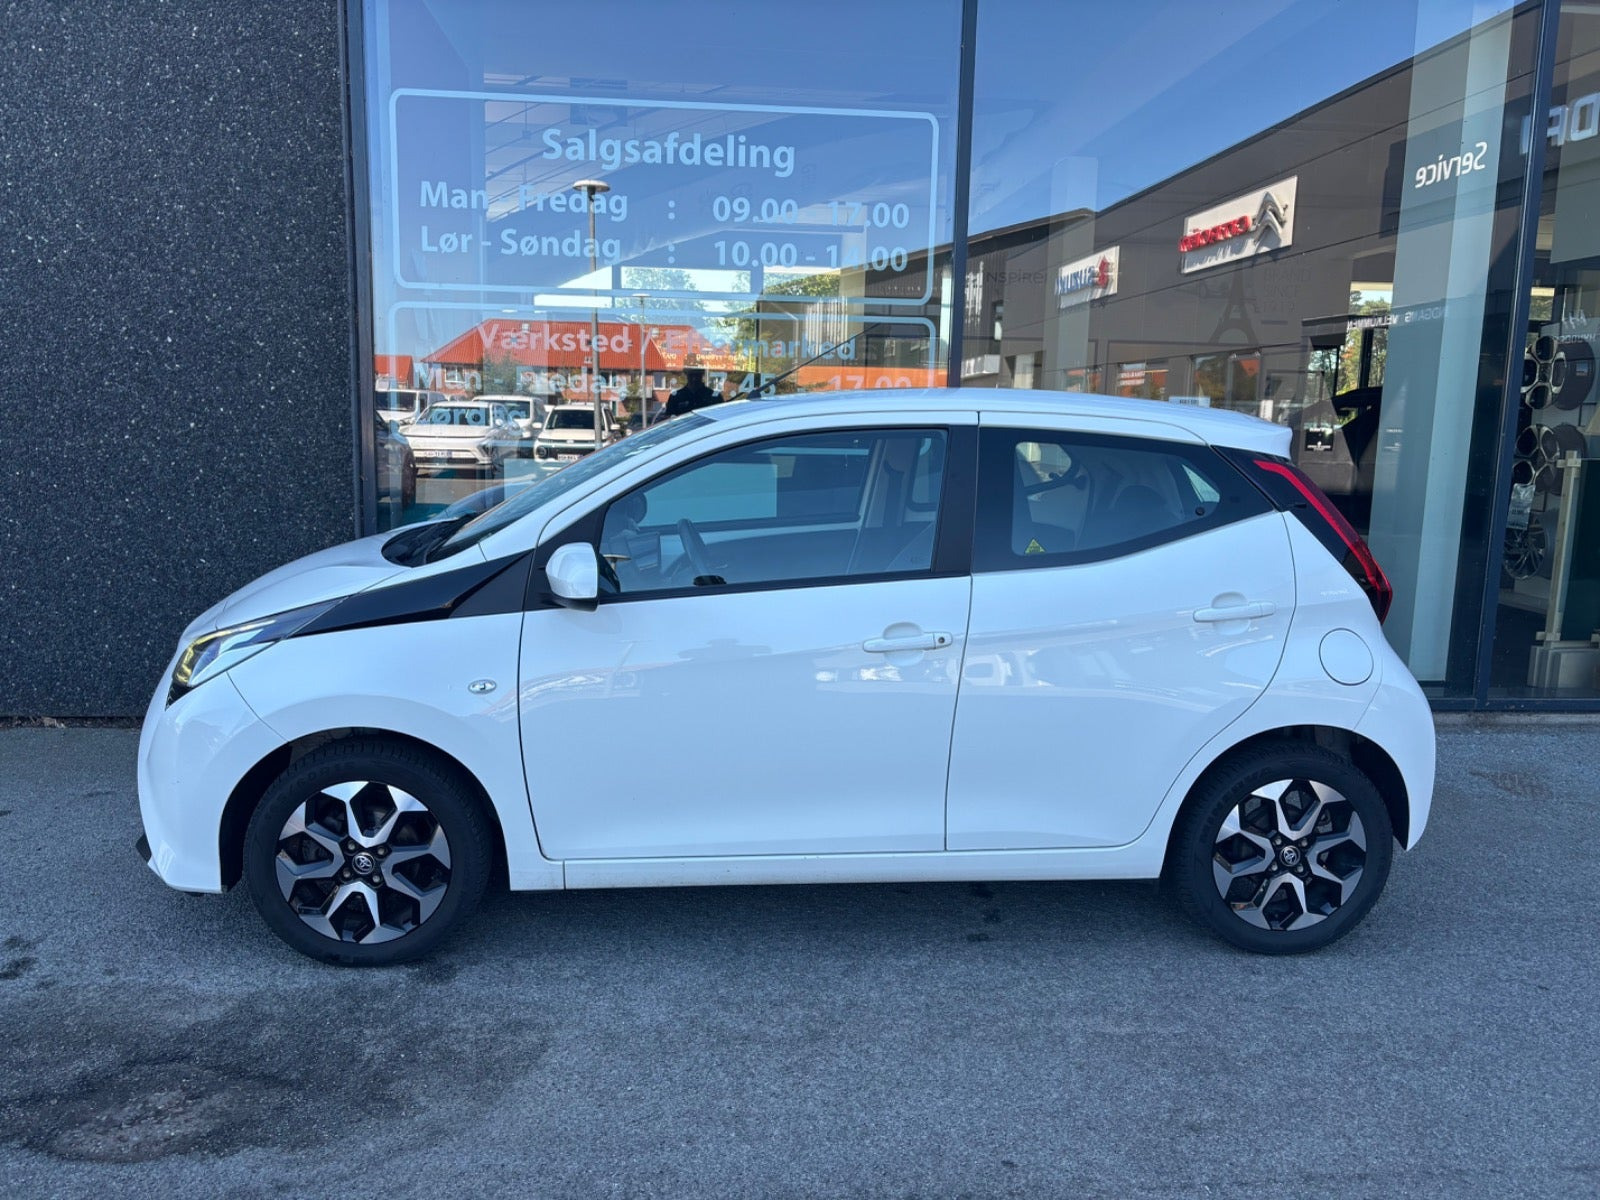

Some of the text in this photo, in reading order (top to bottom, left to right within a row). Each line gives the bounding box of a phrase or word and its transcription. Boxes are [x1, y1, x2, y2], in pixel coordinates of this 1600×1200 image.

[542, 128, 796, 178] Salgsafdeling
[420, 180, 488, 209] Man
[518, 183, 628, 222] Fredag
[713, 196, 799, 224] 09.00
[828, 201, 910, 228] 17.00
[421, 225, 473, 254] Lør
[501, 228, 622, 265] Søndag
[714, 240, 798, 267] 10.00
[826, 245, 908, 272] 14.00
[477, 324, 629, 353] Værksted
